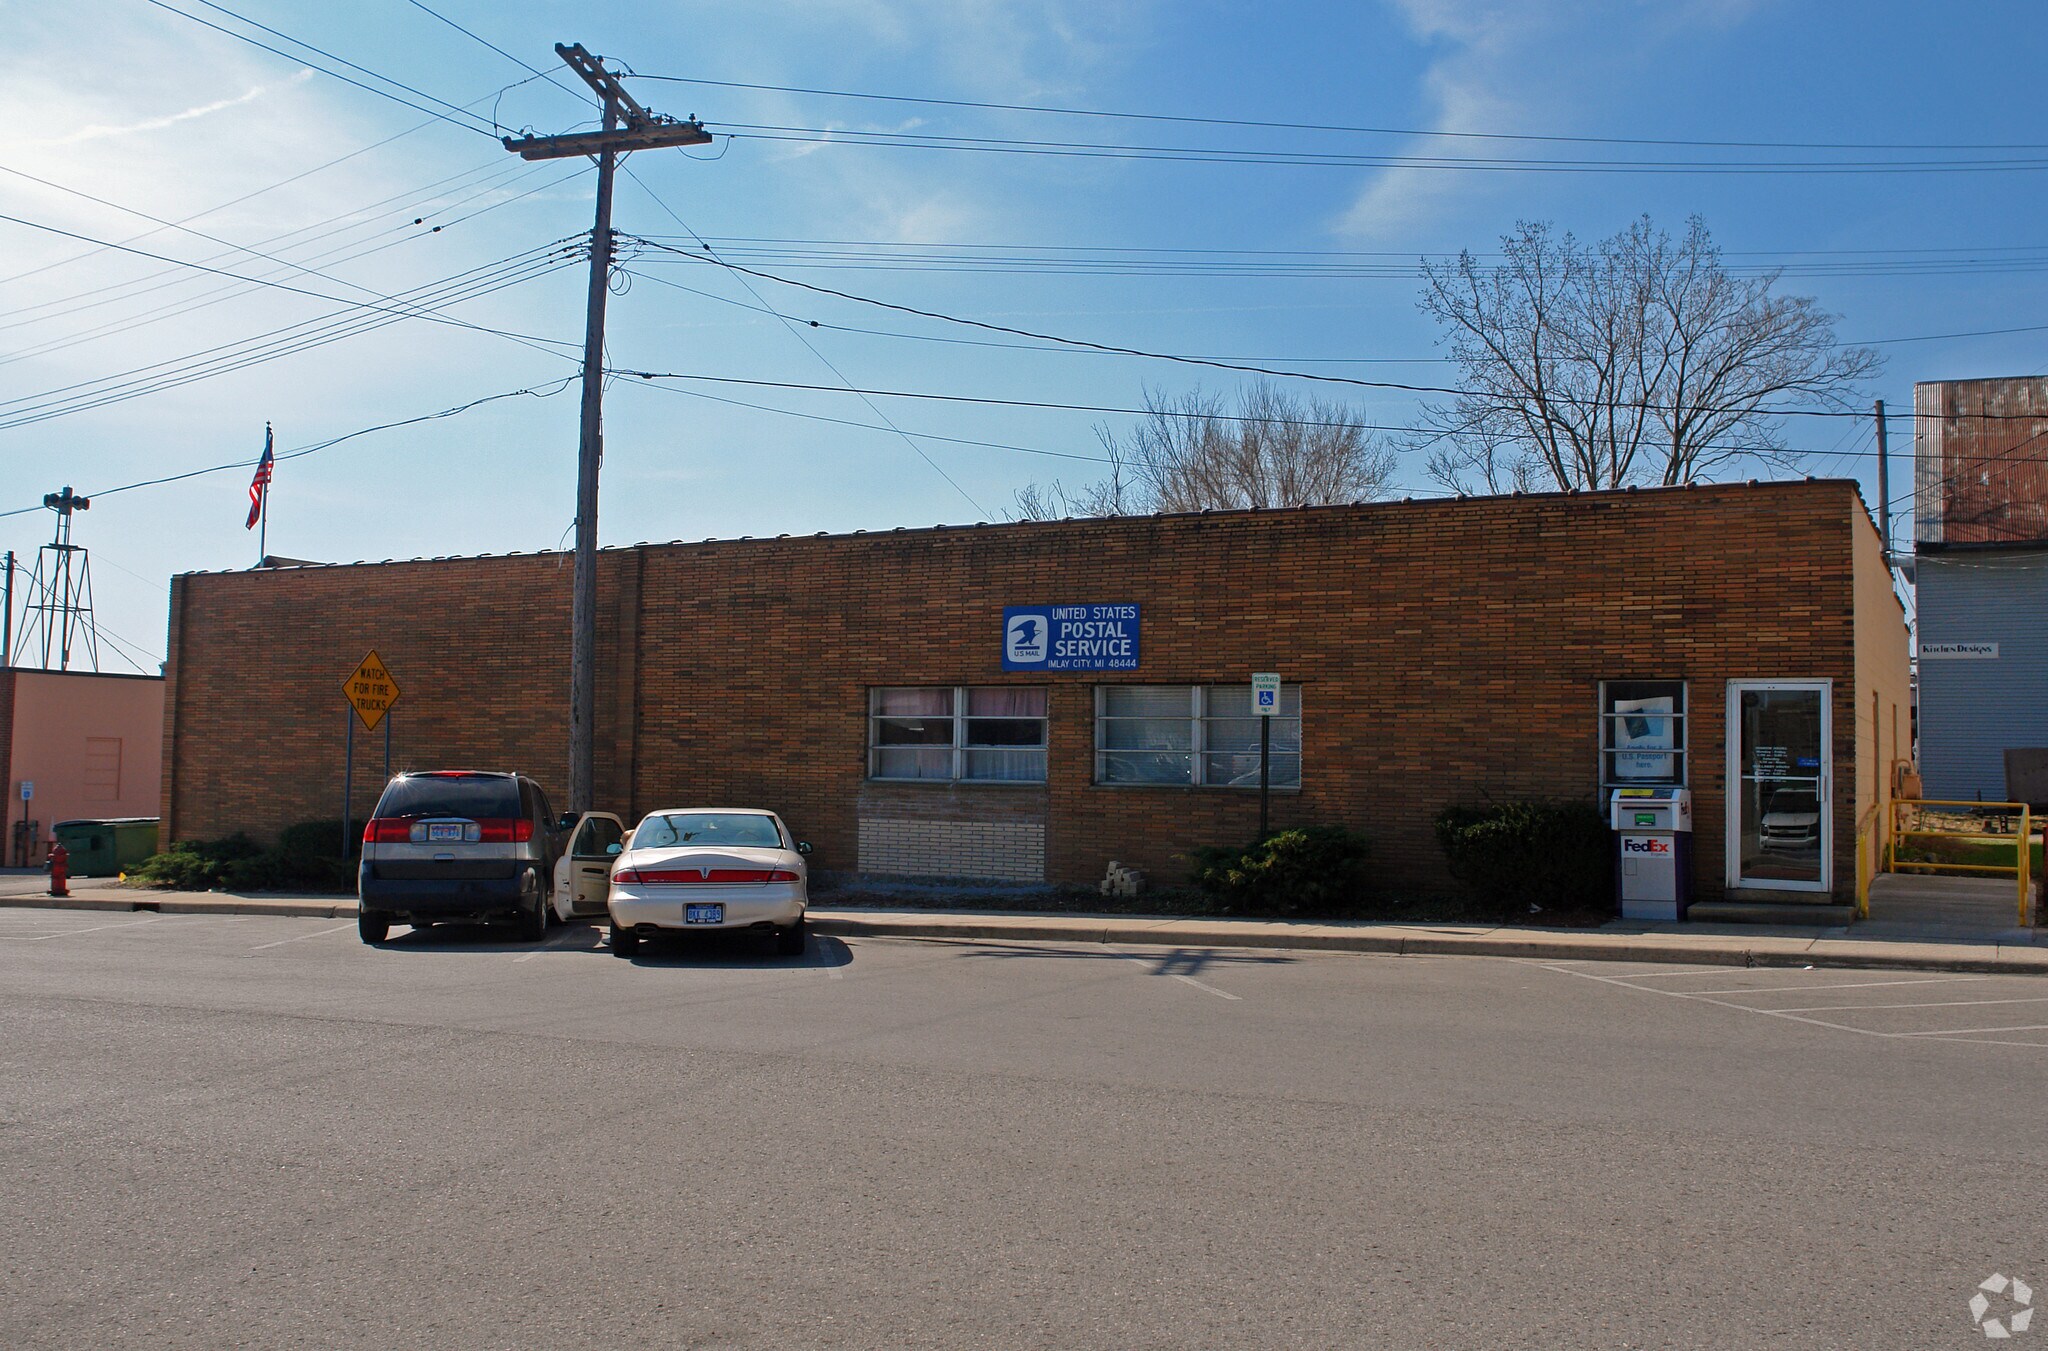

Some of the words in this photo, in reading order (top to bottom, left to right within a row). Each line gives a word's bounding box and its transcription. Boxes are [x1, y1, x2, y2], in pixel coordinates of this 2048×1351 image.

[1052, 608, 1086, 620] UNITED
[1093, 606, 1136, 619] STATES
[1061, 621, 1127, 638] POSTAL
[1055, 639, 1132, 657] SERVICE
[1048, 659, 1070, 668] IMLAY
[1095, 659, 1104, 667] MI
[1108, 658, 1137, 667] 48444
[360, 668, 385, 680] WATCH
[354, 682, 370, 694] FOR
[372, 684, 389, 696] FIRE
[356, 698, 386, 711] TRUCKS
[1624, 839, 1669, 852] FedEx
